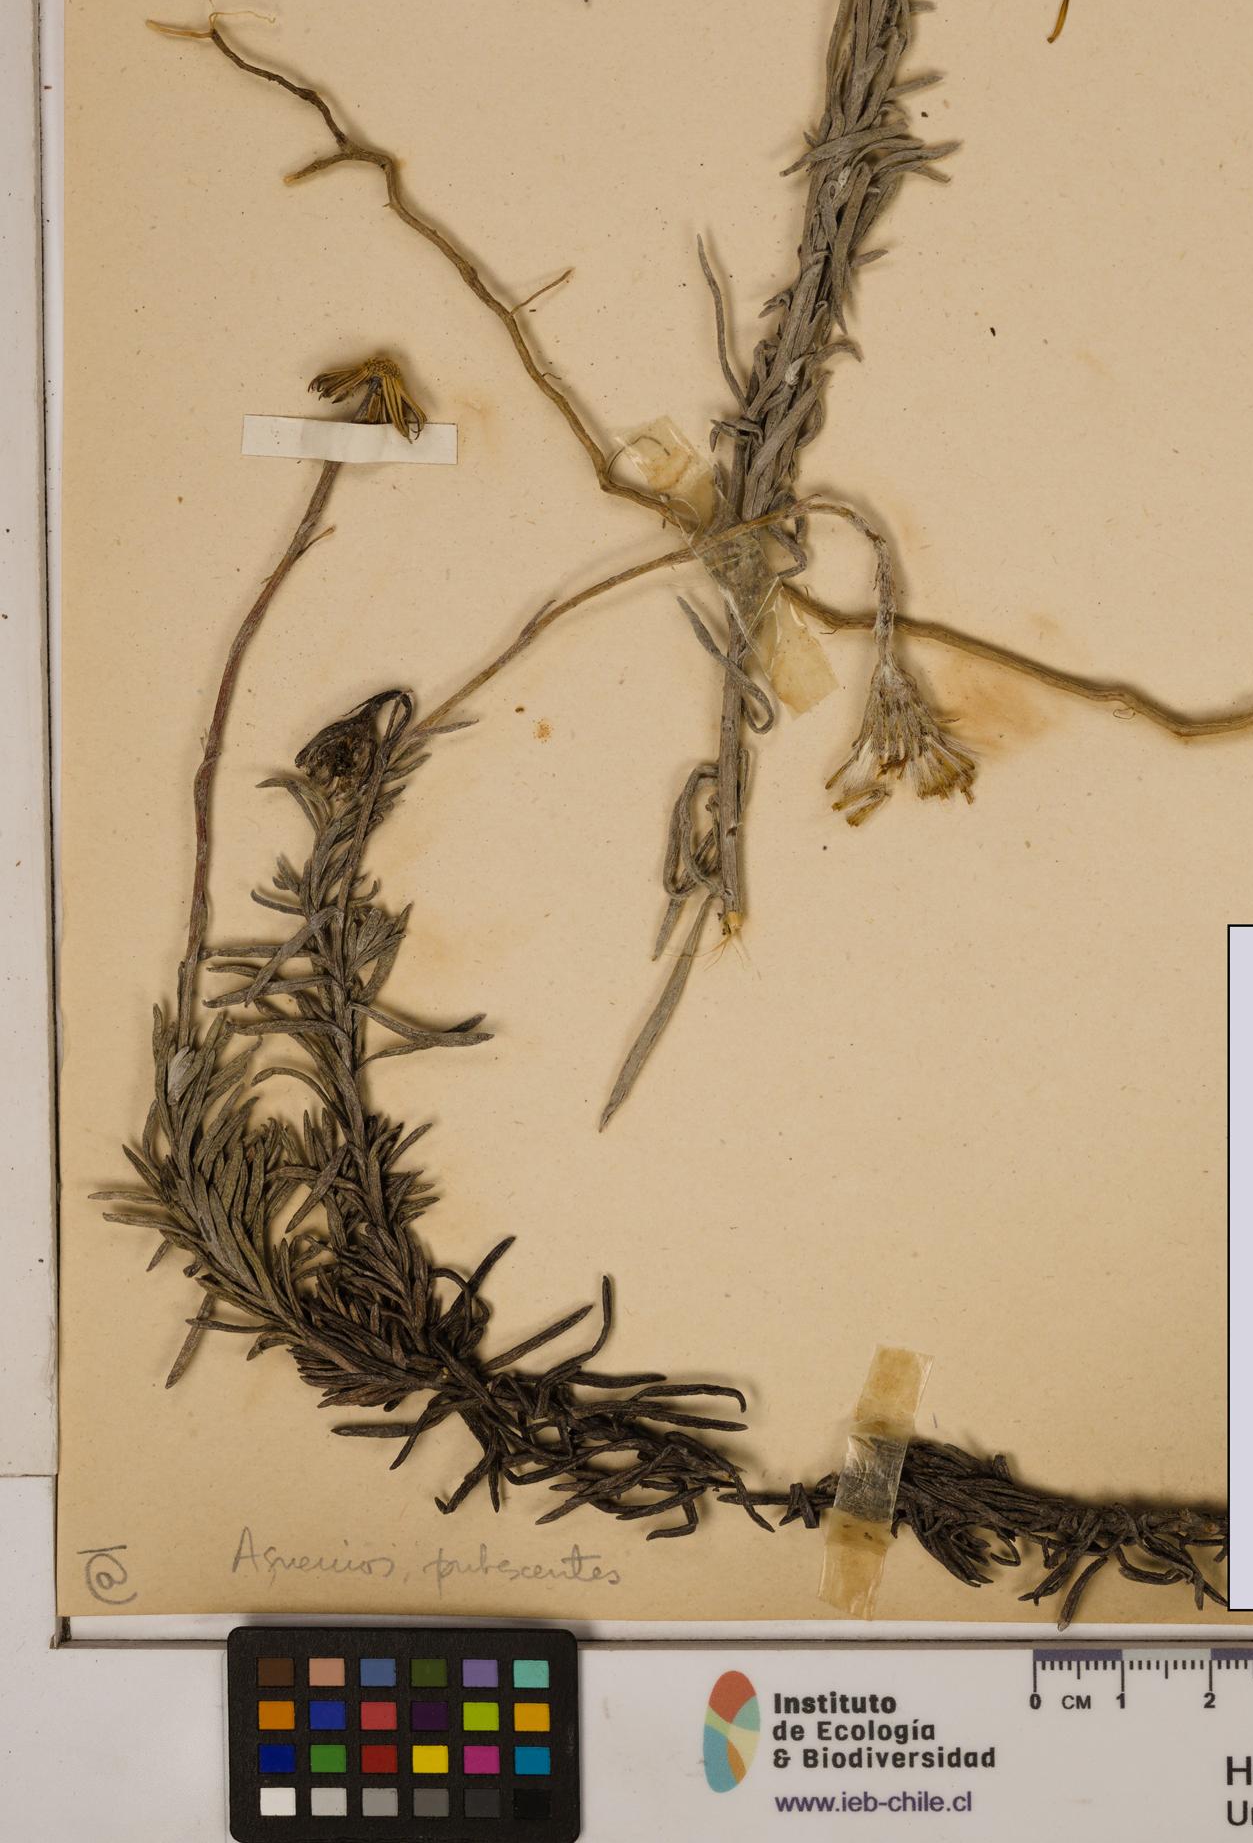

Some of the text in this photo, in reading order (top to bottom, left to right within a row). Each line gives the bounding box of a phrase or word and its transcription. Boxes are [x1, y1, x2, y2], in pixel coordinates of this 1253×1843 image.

[773, 1691, 897, 1715] Instituto
[1030, 1694, 1042, 1710] 0
[1062, 1695, 1092, 1710] CM
[1116, 1693, 1126, 1709] 1
[1203, 1692, 1216, 1708] 2
[772, 1719, 936, 1745] de Ecología
[773, 1747, 996, 1770] & Biodiversidad
[774, 1791, 972, 1813] www.ieb-chile.cl
